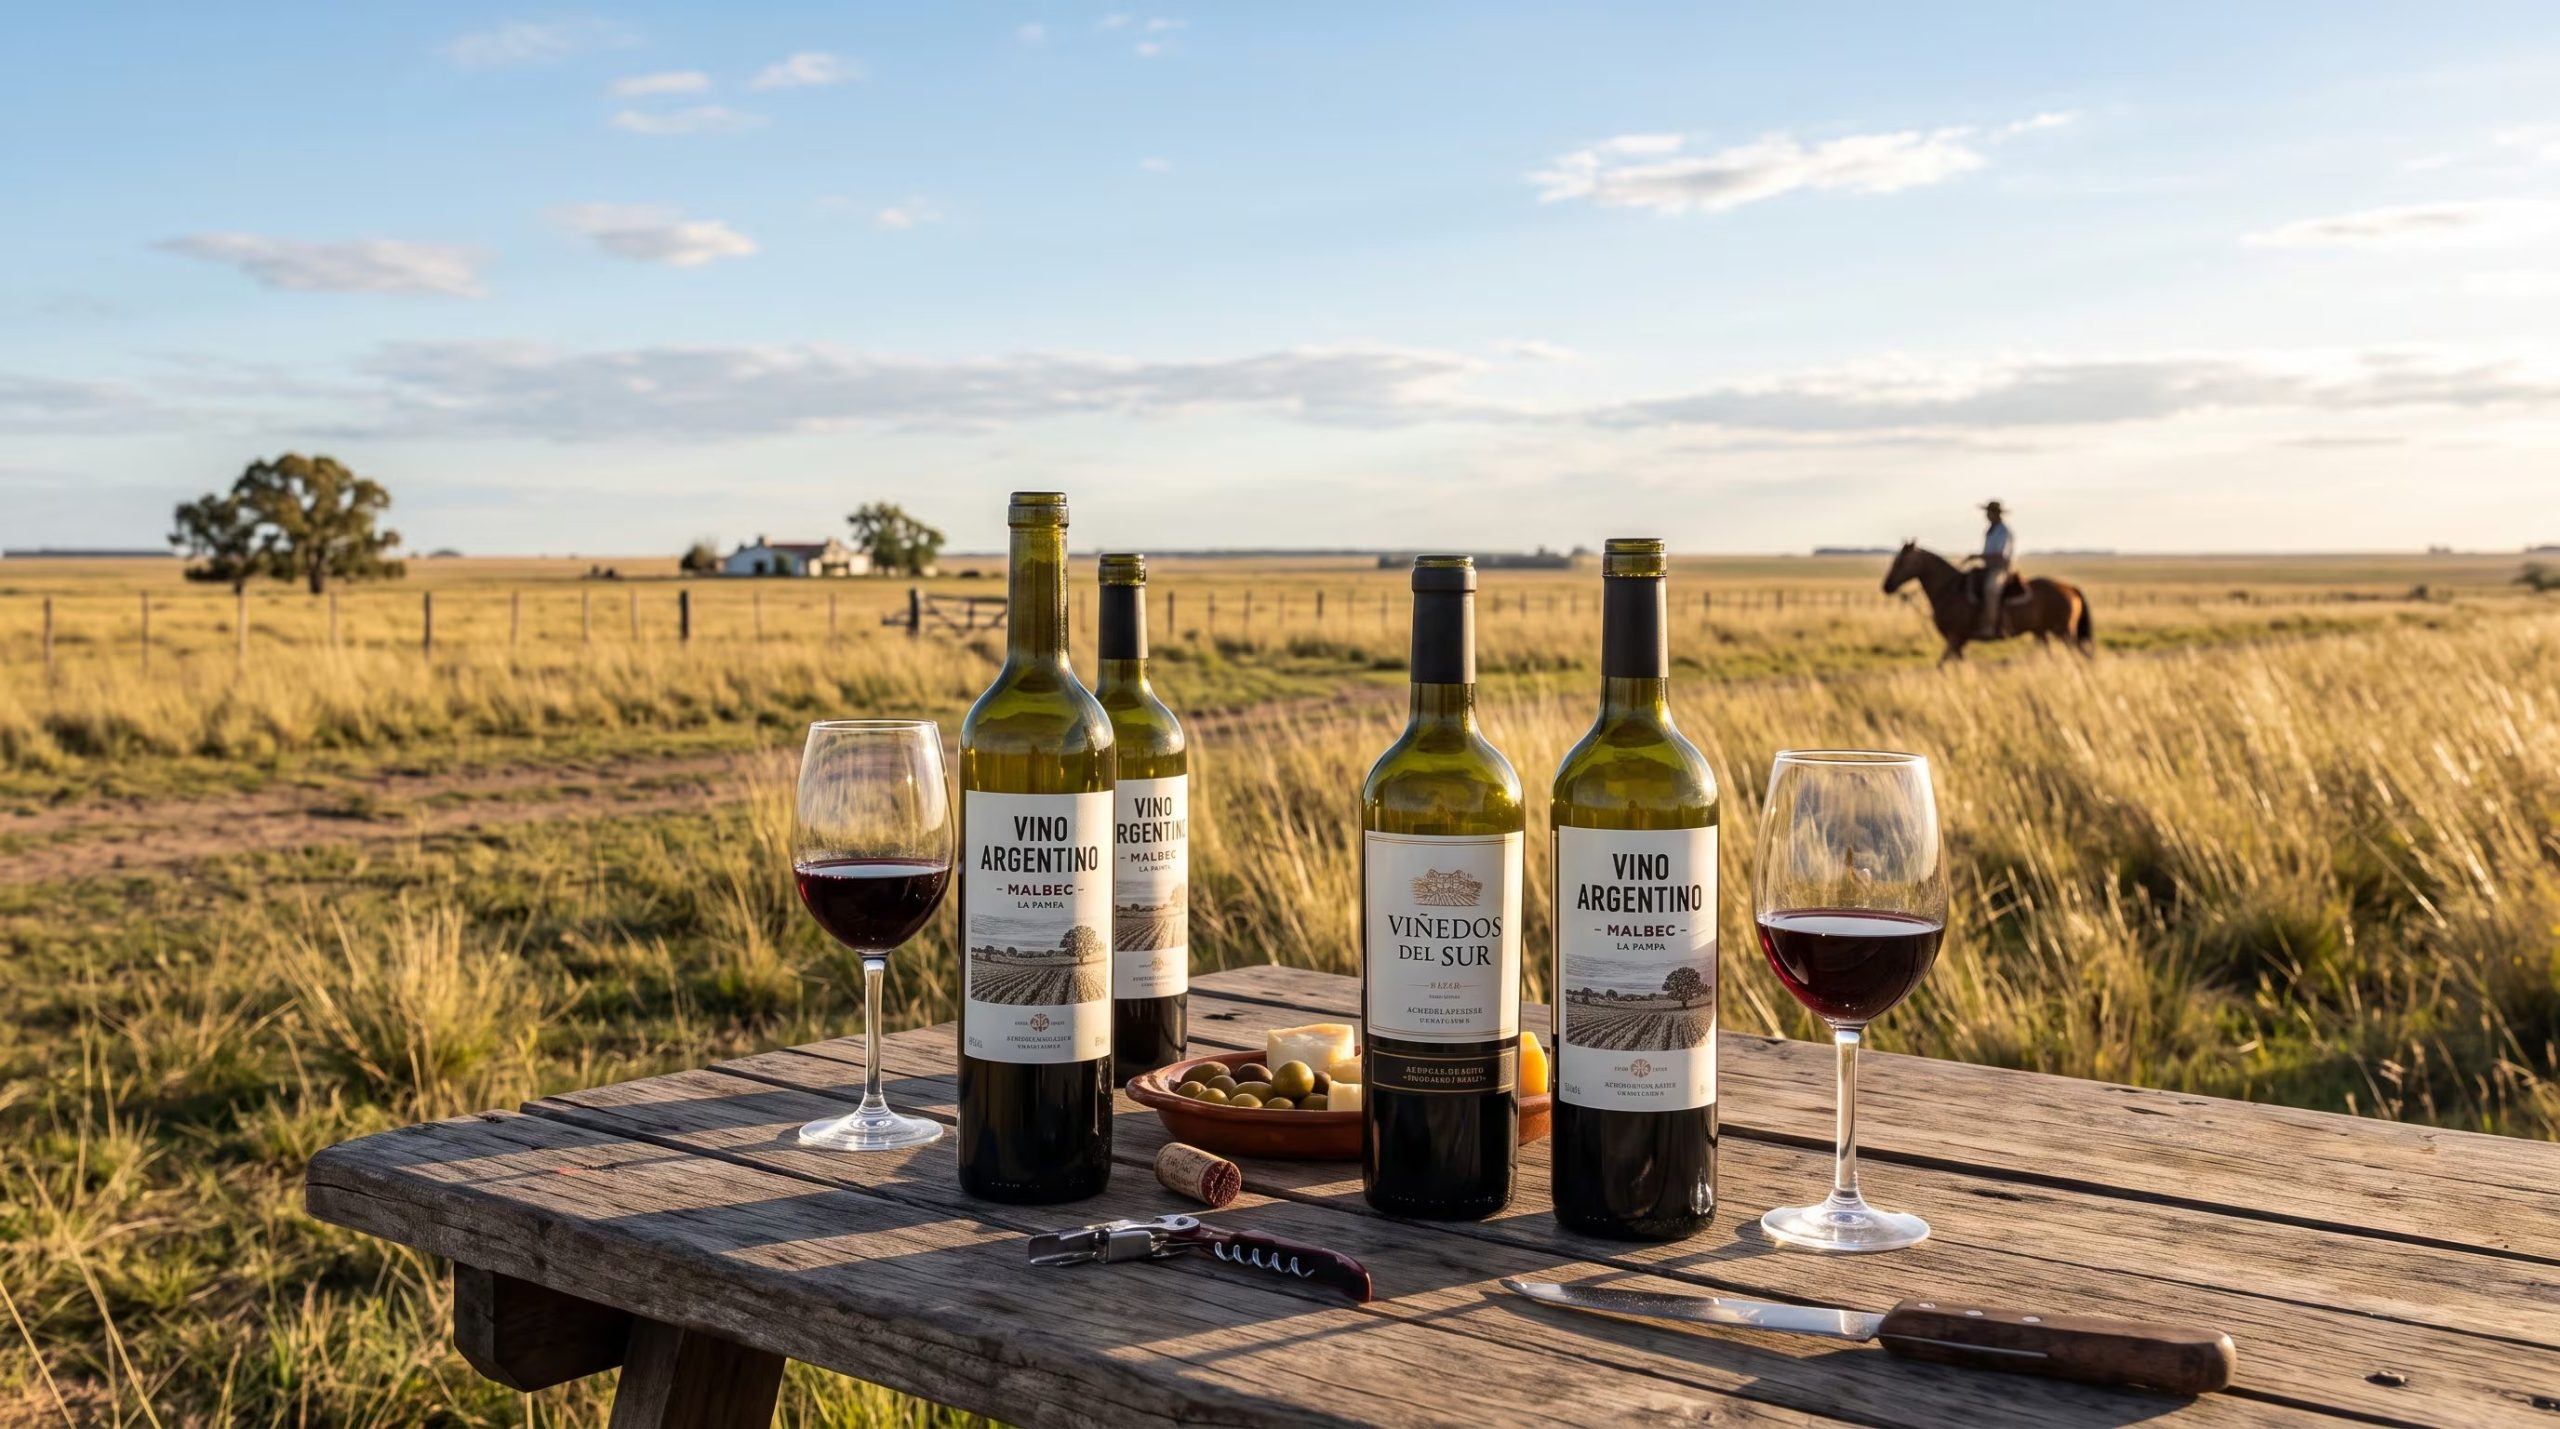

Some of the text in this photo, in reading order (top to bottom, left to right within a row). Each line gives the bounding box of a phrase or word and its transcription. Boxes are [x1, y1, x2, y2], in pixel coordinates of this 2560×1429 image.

[1134, 797, 1172, 818] VINO
[1014, 816, 1068, 842] VINO
[1116, 819, 1186, 844] RGENTINO
[981, 845, 1098, 873] ARGENTINO
[1130, 850, 1176, 862] MALBEC
[1612, 853, 1669, 881] VINO
[1008, 884, 1073, 896] MALBEC
[1577, 883, 1702, 913] ARGENTINO
[1017, 901, 1029, 909] LA
[1388, 913, 1502, 939] VIÑEDOS
[1607, 924, 1676, 937] MALBEC
[1399, 945, 1491, 967] DEL SUR
[1616, 942, 1666, 951] LA PAMPA
